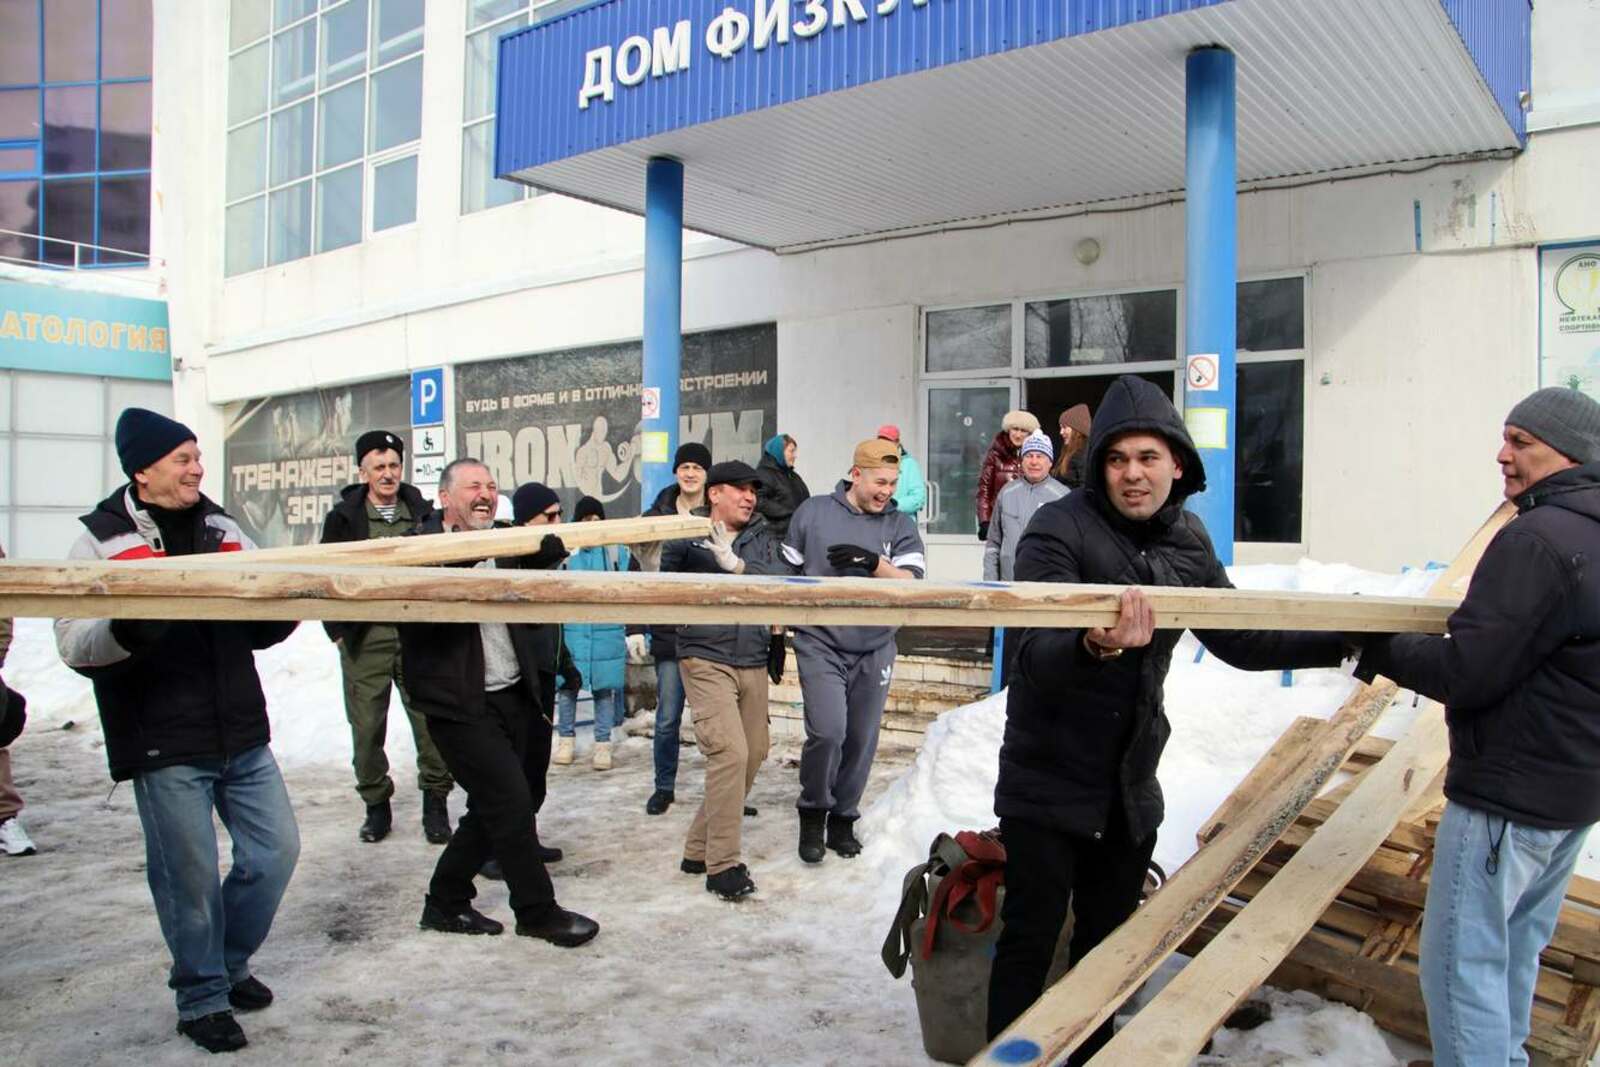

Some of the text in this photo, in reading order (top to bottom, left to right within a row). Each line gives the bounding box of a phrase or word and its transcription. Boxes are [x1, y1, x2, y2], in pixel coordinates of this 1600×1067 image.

[579, 20, 691, 110] ДОМ
[0, 309, 168, 354] АТОЛОГИЯ
[420, 378, 437, 417] P
[466, 370, 768, 413] БУДЬ В ФОРМЕ И В ОТЛИЧН СТРОЕНИИ
[466, 424, 582, 490] IRON
[287, 494, 334, 525] ЗАЛ
